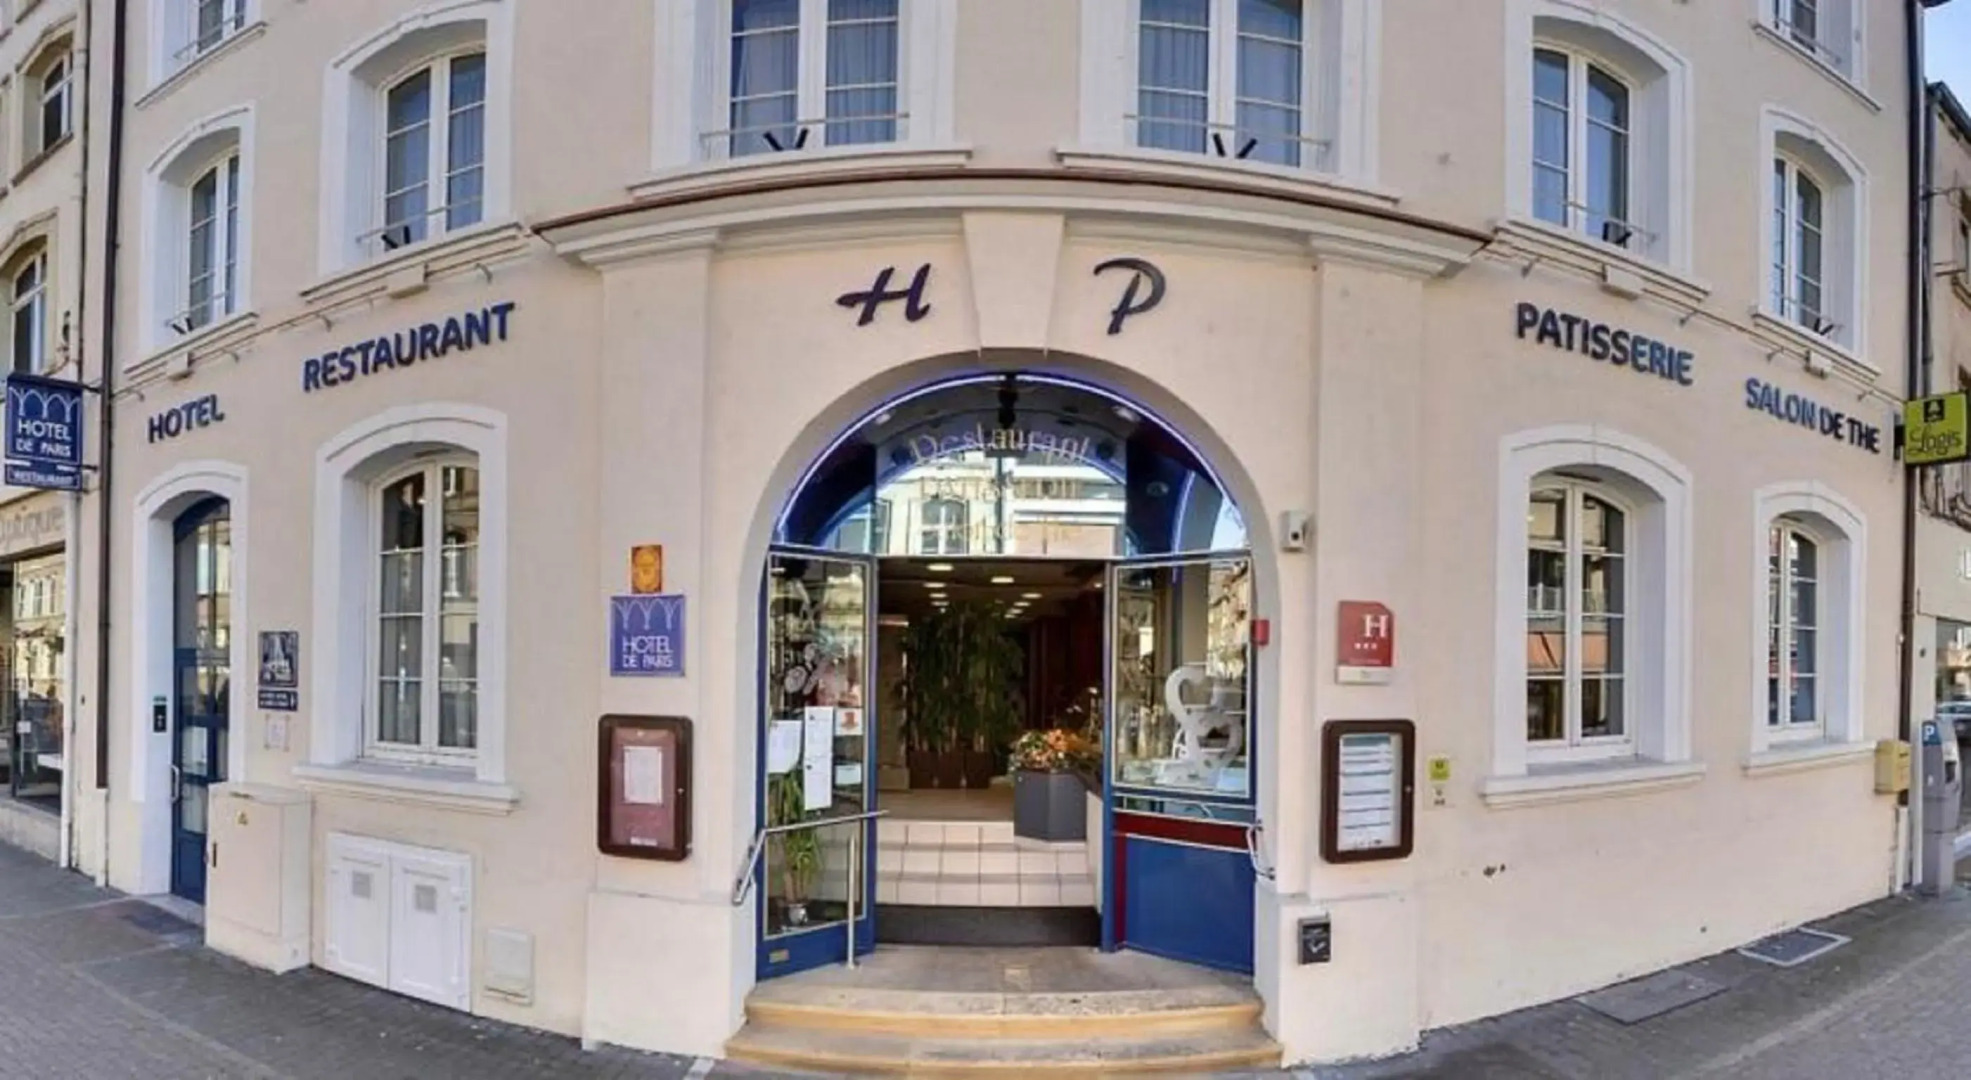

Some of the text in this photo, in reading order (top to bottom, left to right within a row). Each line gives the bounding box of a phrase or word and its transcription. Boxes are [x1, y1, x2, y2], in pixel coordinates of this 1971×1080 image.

[836, 257, 1166, 334] H P
[303, 302, 515, 392] RESTAURANT
[1516, 302, 1694, 386] PATISSERIE
[148, 394, 224, 443] HOTEL
[1745, 378, 1880, 453] SALON DE THE
[18, 420, 71, 441] HOTEL
[16, 438, 71, 457] DE PARIS
[1364, 614, 1388, 638] H
[622, 635, 673, 654] HOTEL
[622, 654, 673, 668] DE PARIS
[1923, 725, 1935, 740] P
